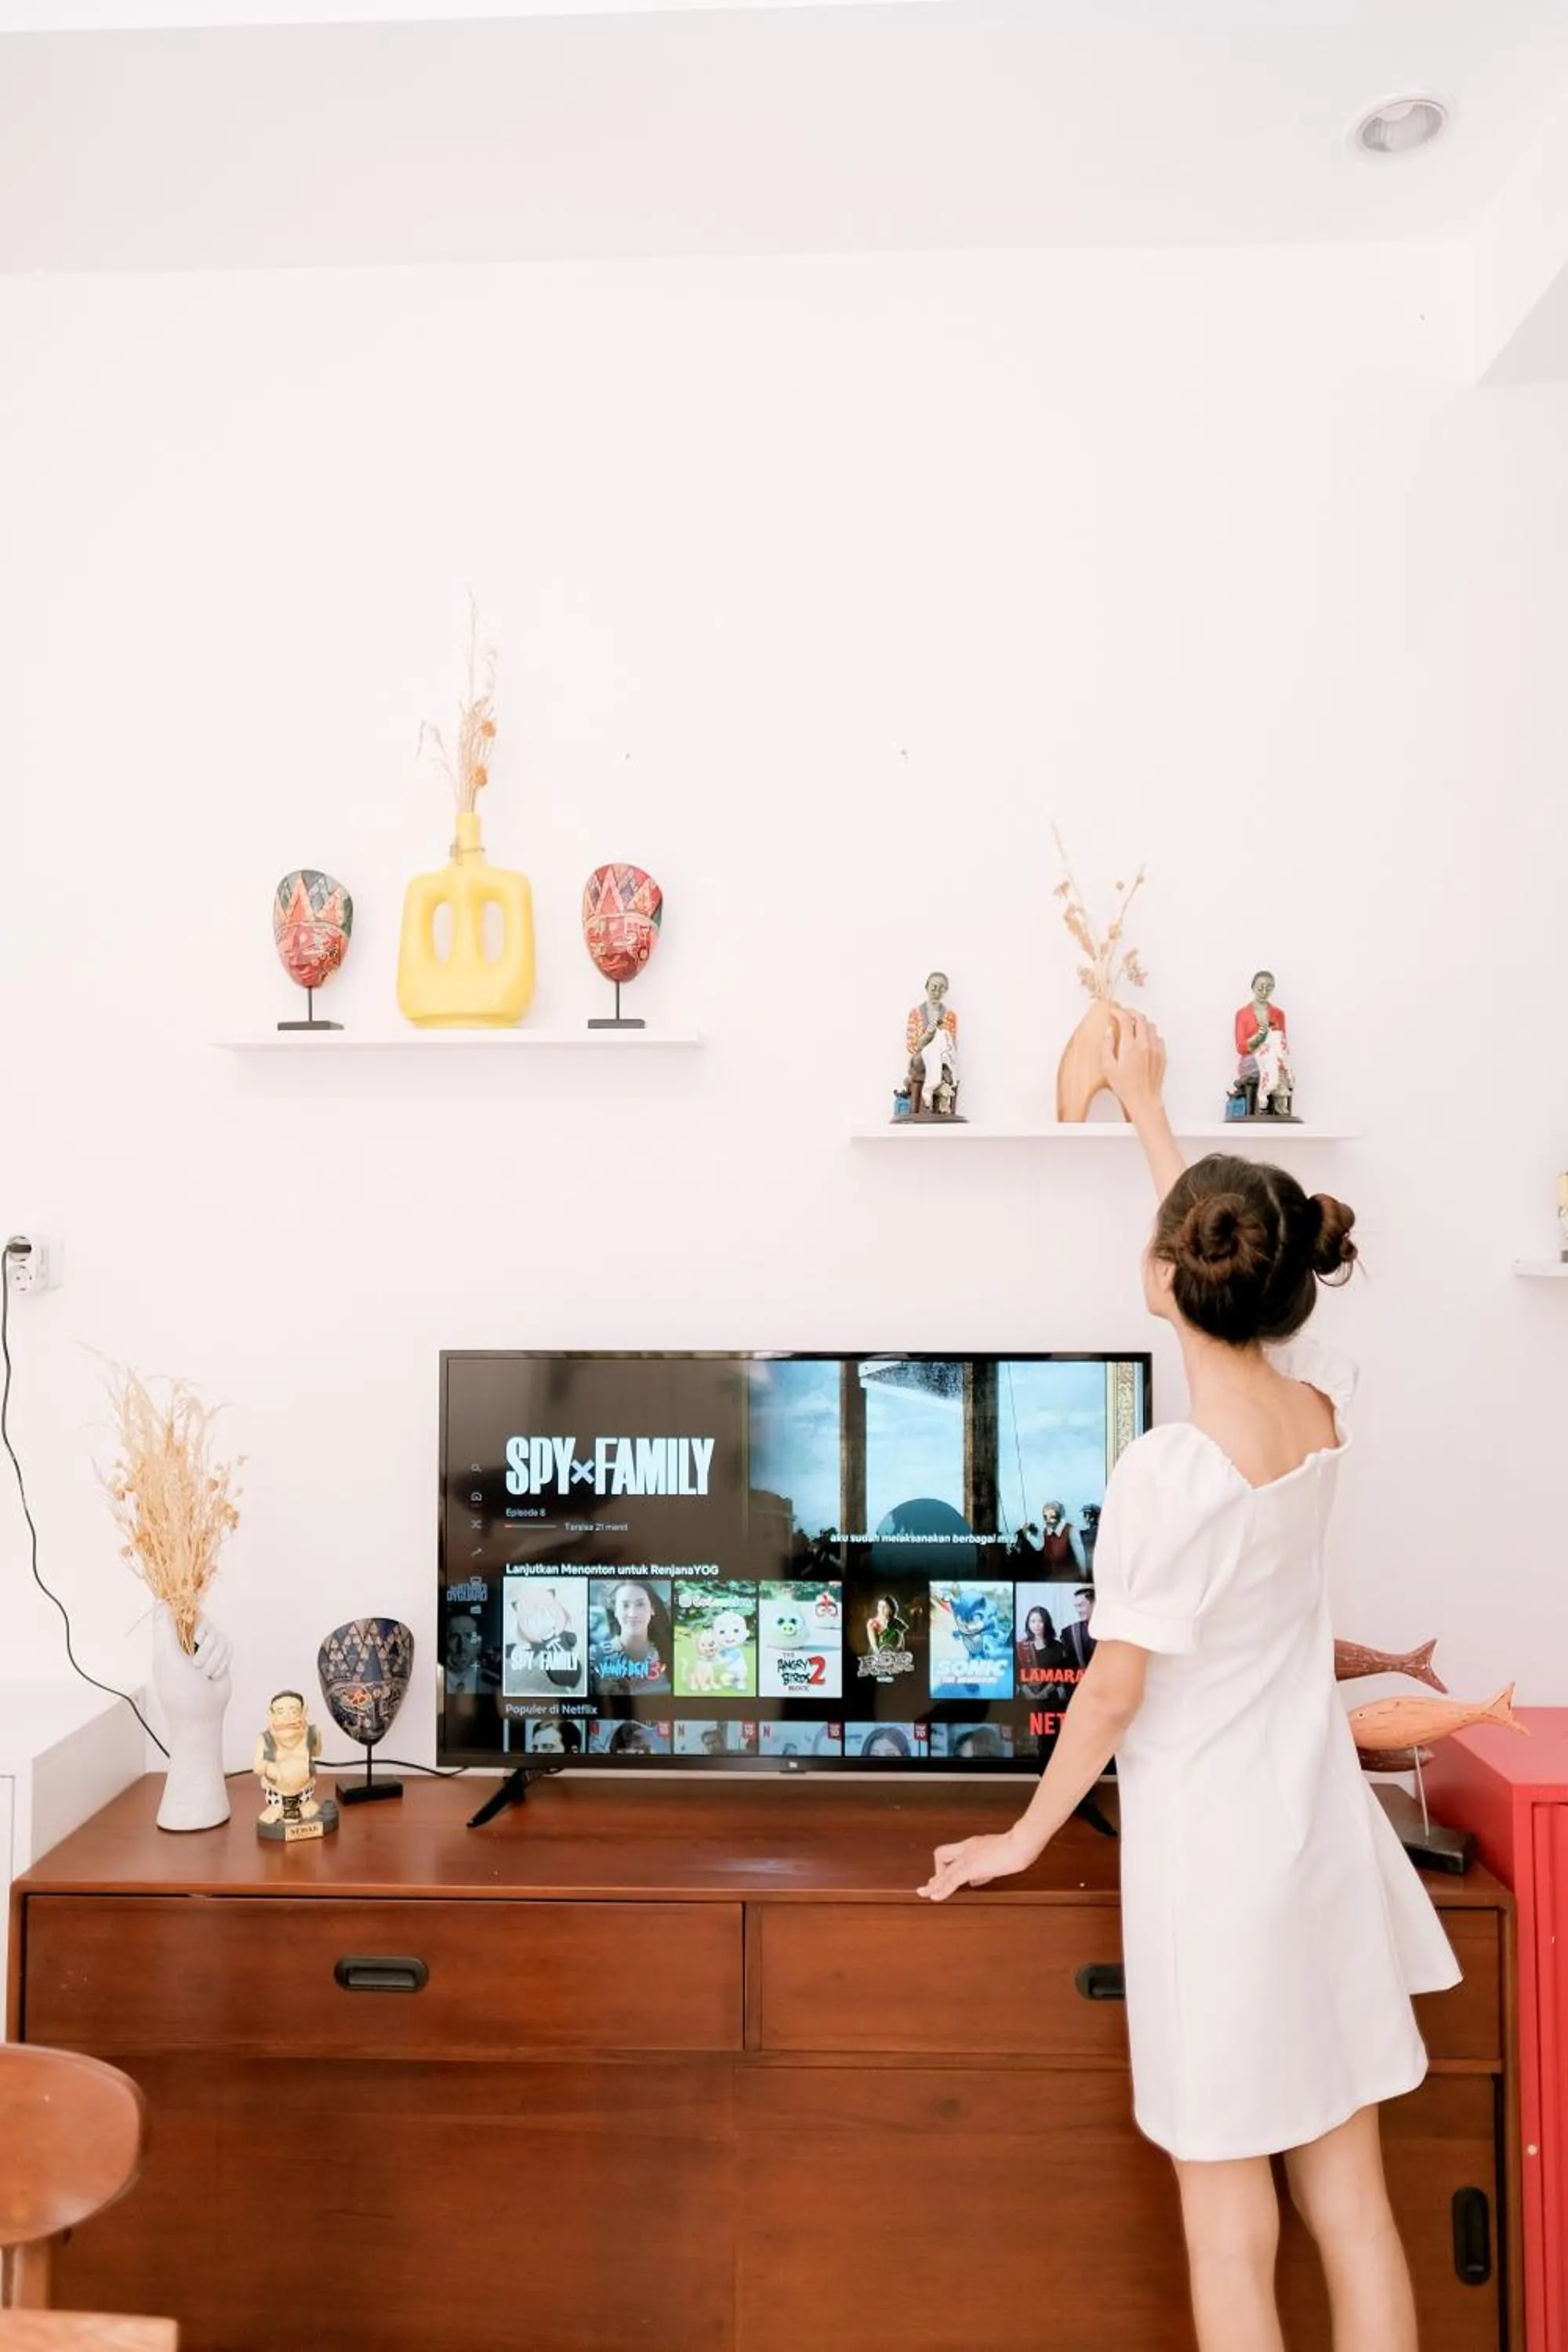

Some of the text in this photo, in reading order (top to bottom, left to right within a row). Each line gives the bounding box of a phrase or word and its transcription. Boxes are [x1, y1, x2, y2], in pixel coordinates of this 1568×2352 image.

[506, 1508, 546, 1517] Episode 8
[829, 1534, 848, 1543] aku
[881, 1534, 951, 1543] melaksanakan
[506, 1563, 719, 1577] Lanjutkan Menonton untuk RenjanaYOG
[778, 1656, 826, 1685] ANGRY 2
[935, 1658, 1010, 1677] SONIC
[506, 1704, 598, 1716] Populer di Netflix
